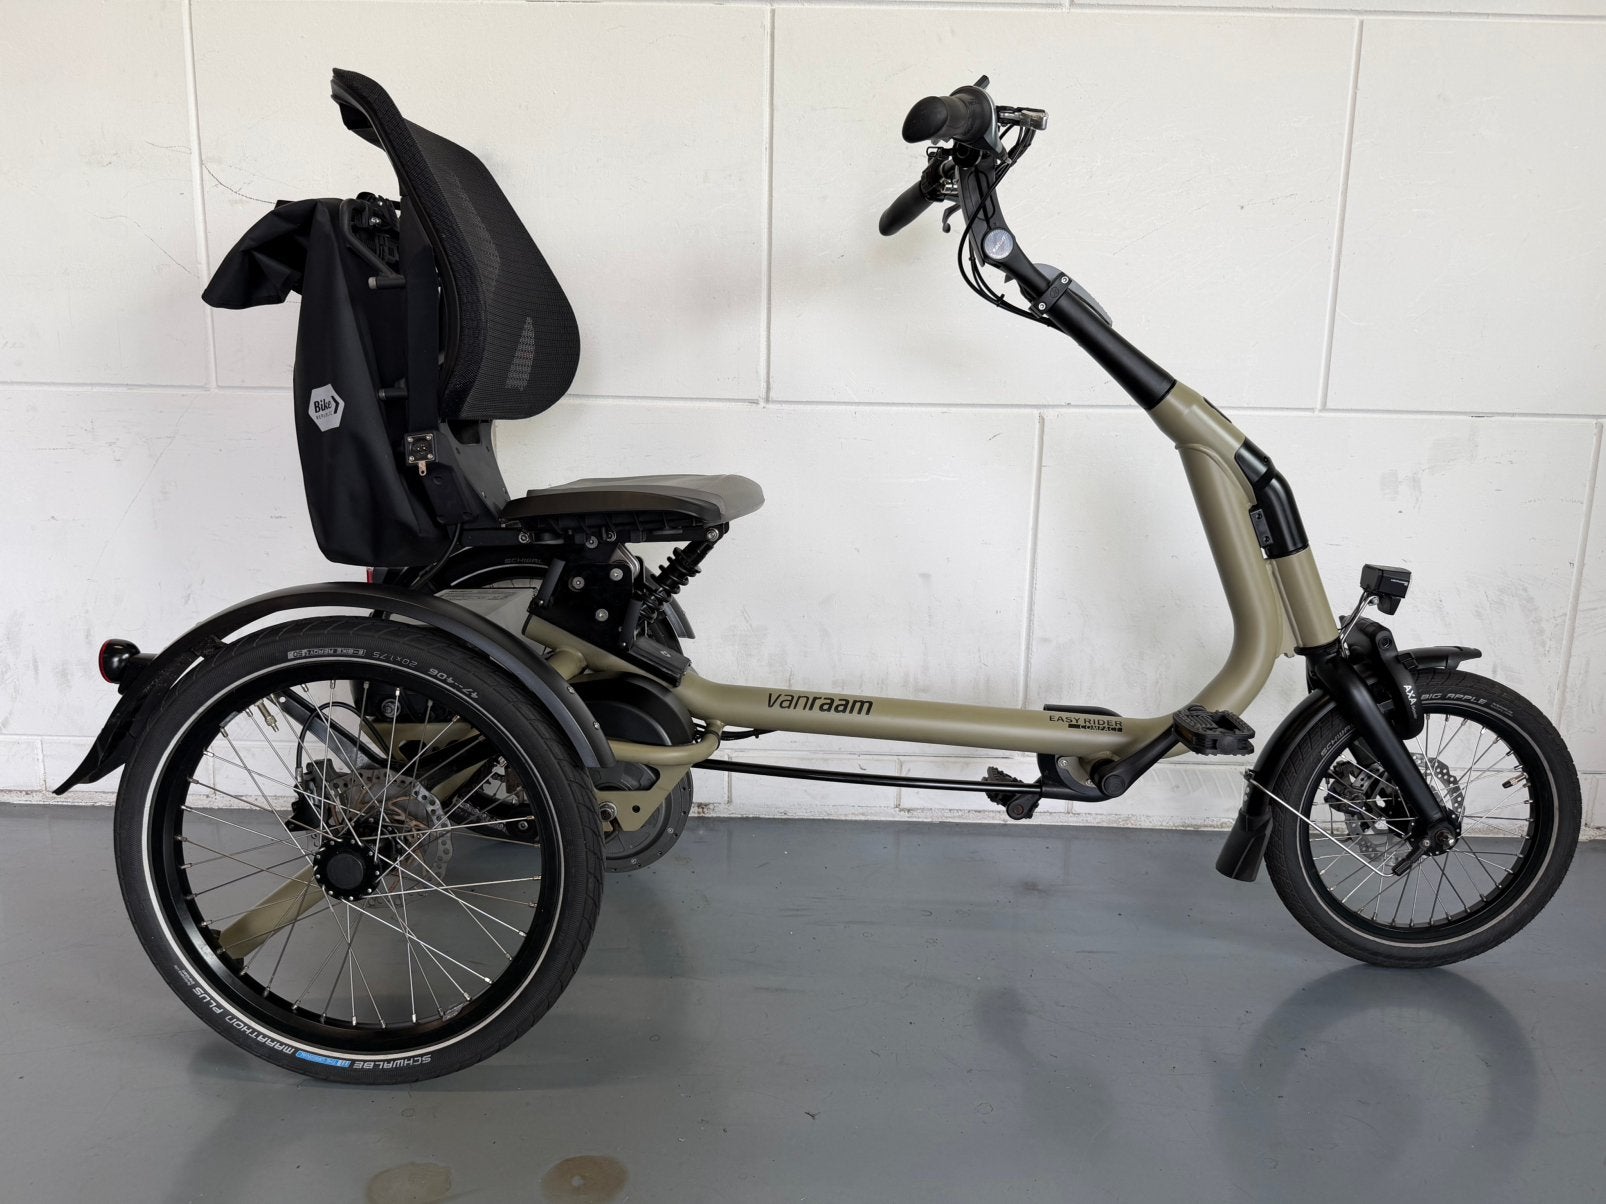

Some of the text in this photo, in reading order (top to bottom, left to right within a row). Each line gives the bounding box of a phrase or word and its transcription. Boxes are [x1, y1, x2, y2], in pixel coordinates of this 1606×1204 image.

[314, 398, 332, 413] Bike
[1403, 685, 1417, 706] AXA
[1445, 693, 1488, 705] APPLE
[767, 692, 874, 715] vanraam
[1049, 715, 1123, 727] EASY RIDER
[192, 986, 224, 1015] PLUS
[353, 1055, 432, 1069] SCHWALBE
